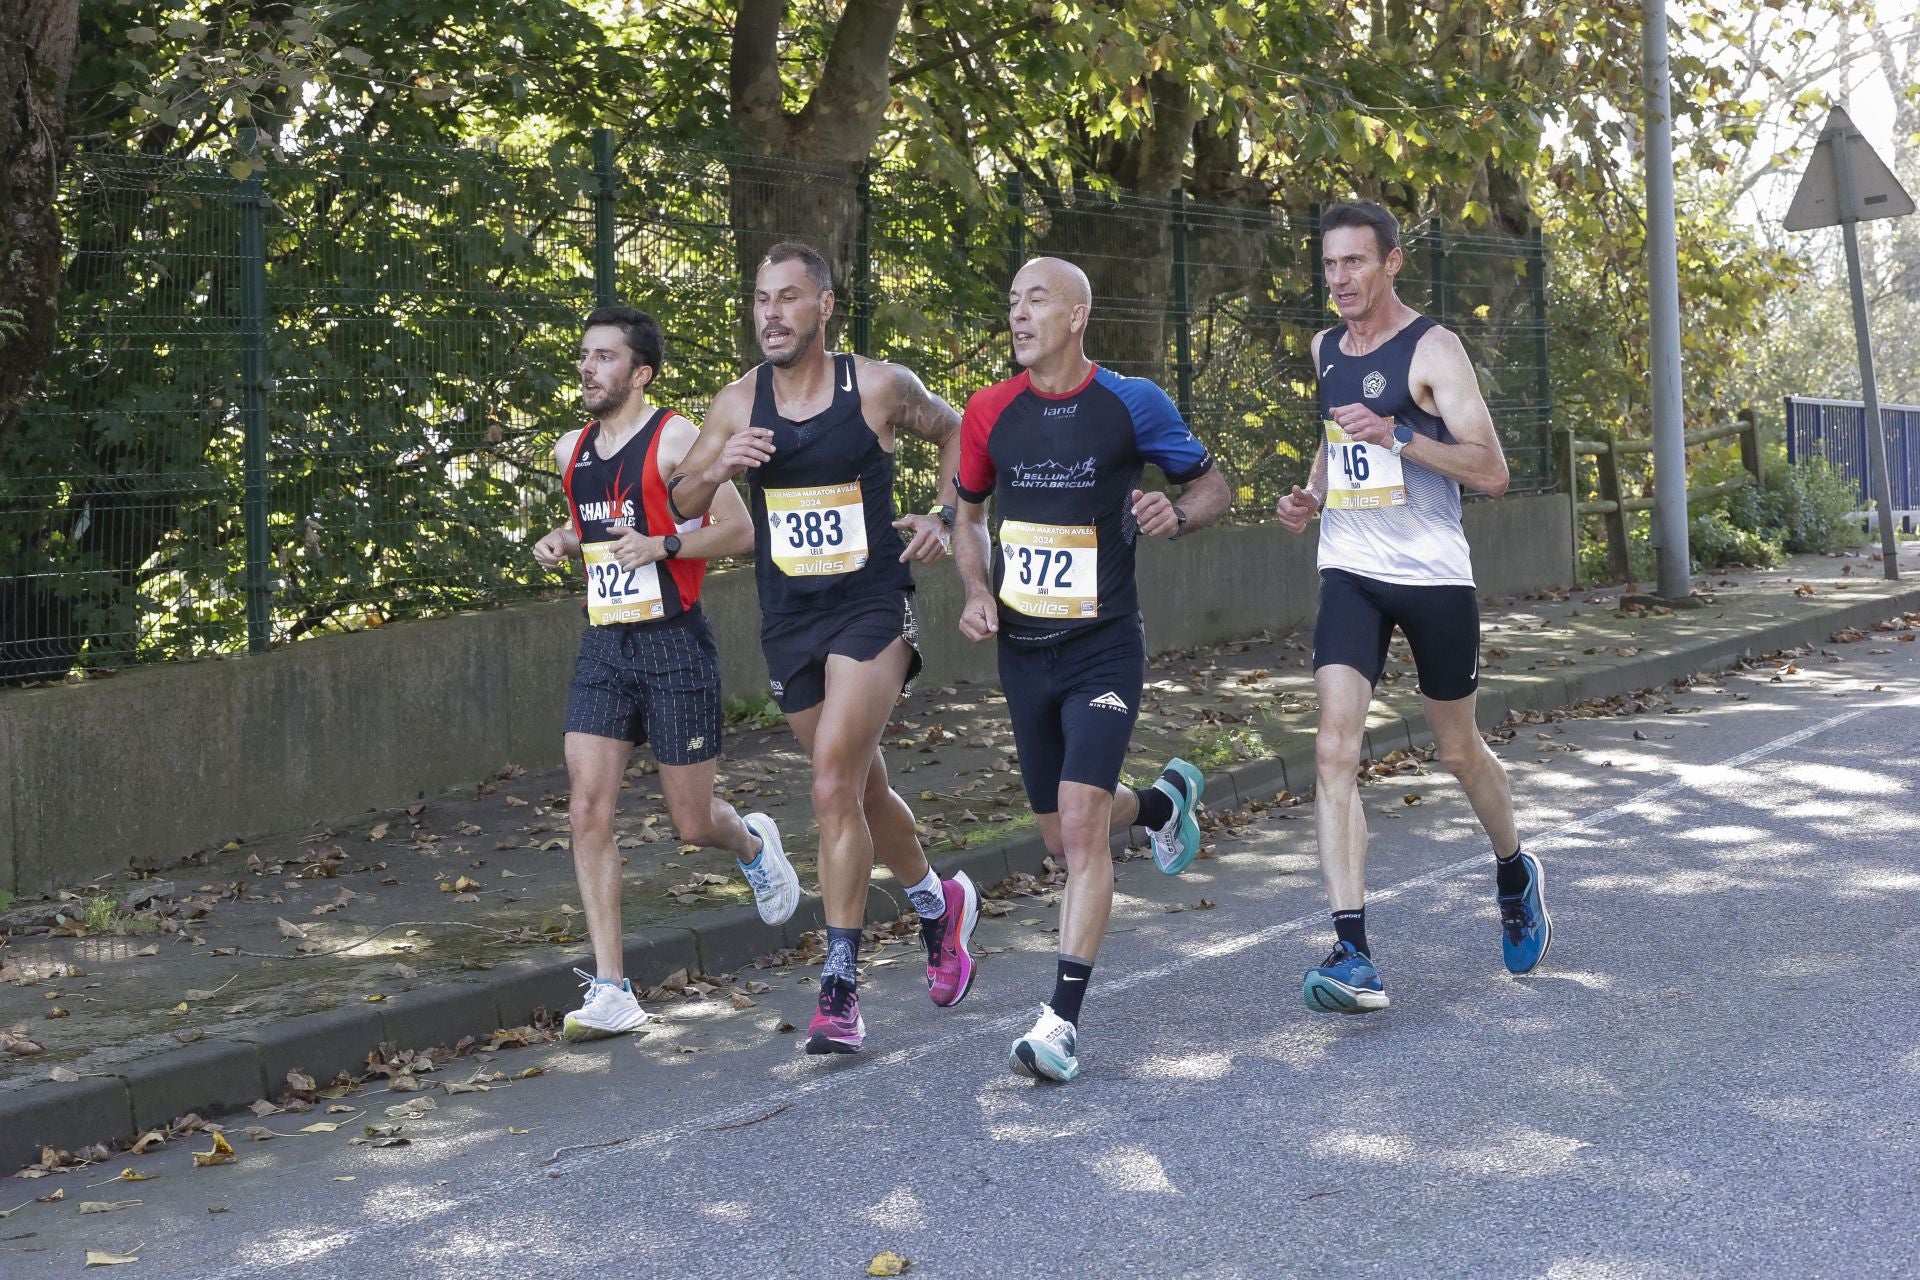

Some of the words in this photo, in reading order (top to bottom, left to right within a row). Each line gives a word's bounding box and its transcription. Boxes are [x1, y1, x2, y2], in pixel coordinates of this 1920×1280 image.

[1043, 403, 1078, 416] land
[1342, 444, 1369, 481] 46
[1023, 473, 1071, 481] BELLUM
[1011, 480, 1095, 489] CANTABRICUM
[800, 499, 821, 507] 2024
[786, 510, 843, 548] 383
[1033, 536, 1054, 544] 2024
[1018, 547, 1073, 588] 372
[596, 563, 639, 598] 322
